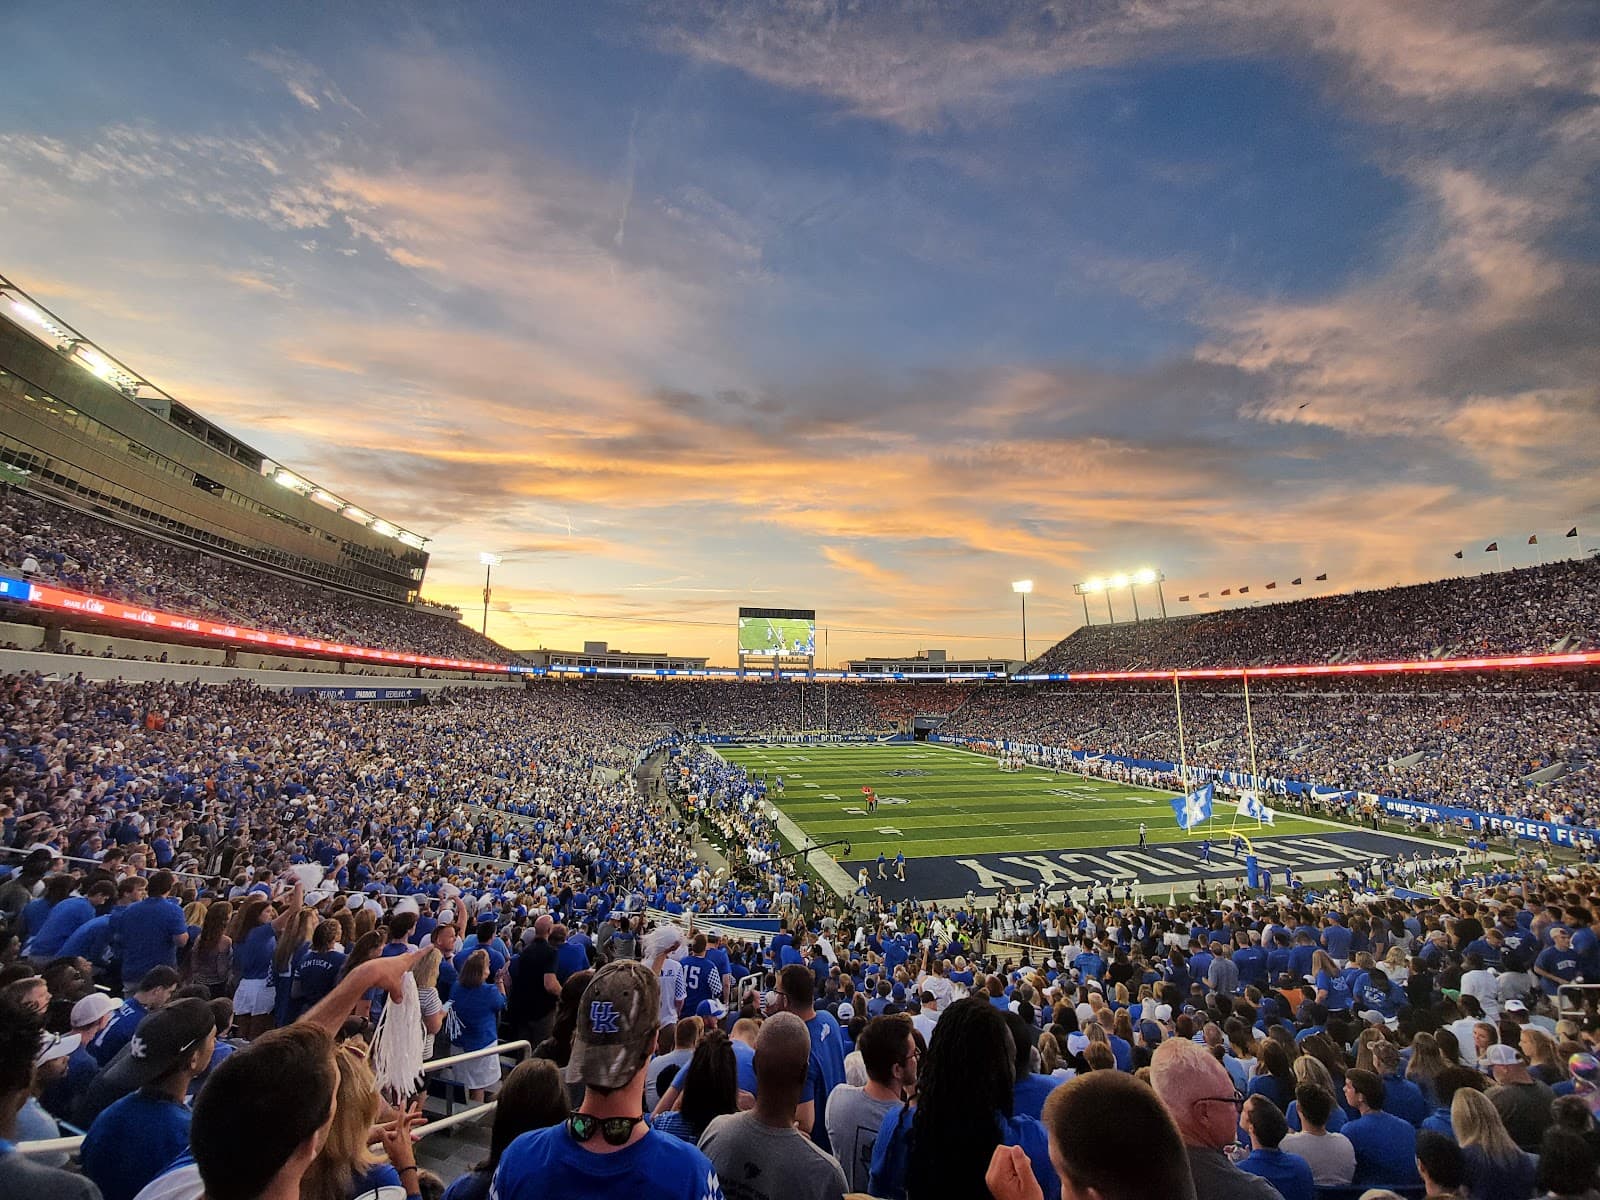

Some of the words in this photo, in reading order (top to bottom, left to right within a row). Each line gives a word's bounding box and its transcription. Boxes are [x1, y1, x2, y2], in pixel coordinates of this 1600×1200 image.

[86, 598, 105, 614] Coke
[1229, 771, 1287, 795] WILDCATS
[956, 838, 1392, 889] KENTUCKY
[682, 963, 701, 990] 15
[590, 1001, 620, 1033] UK
